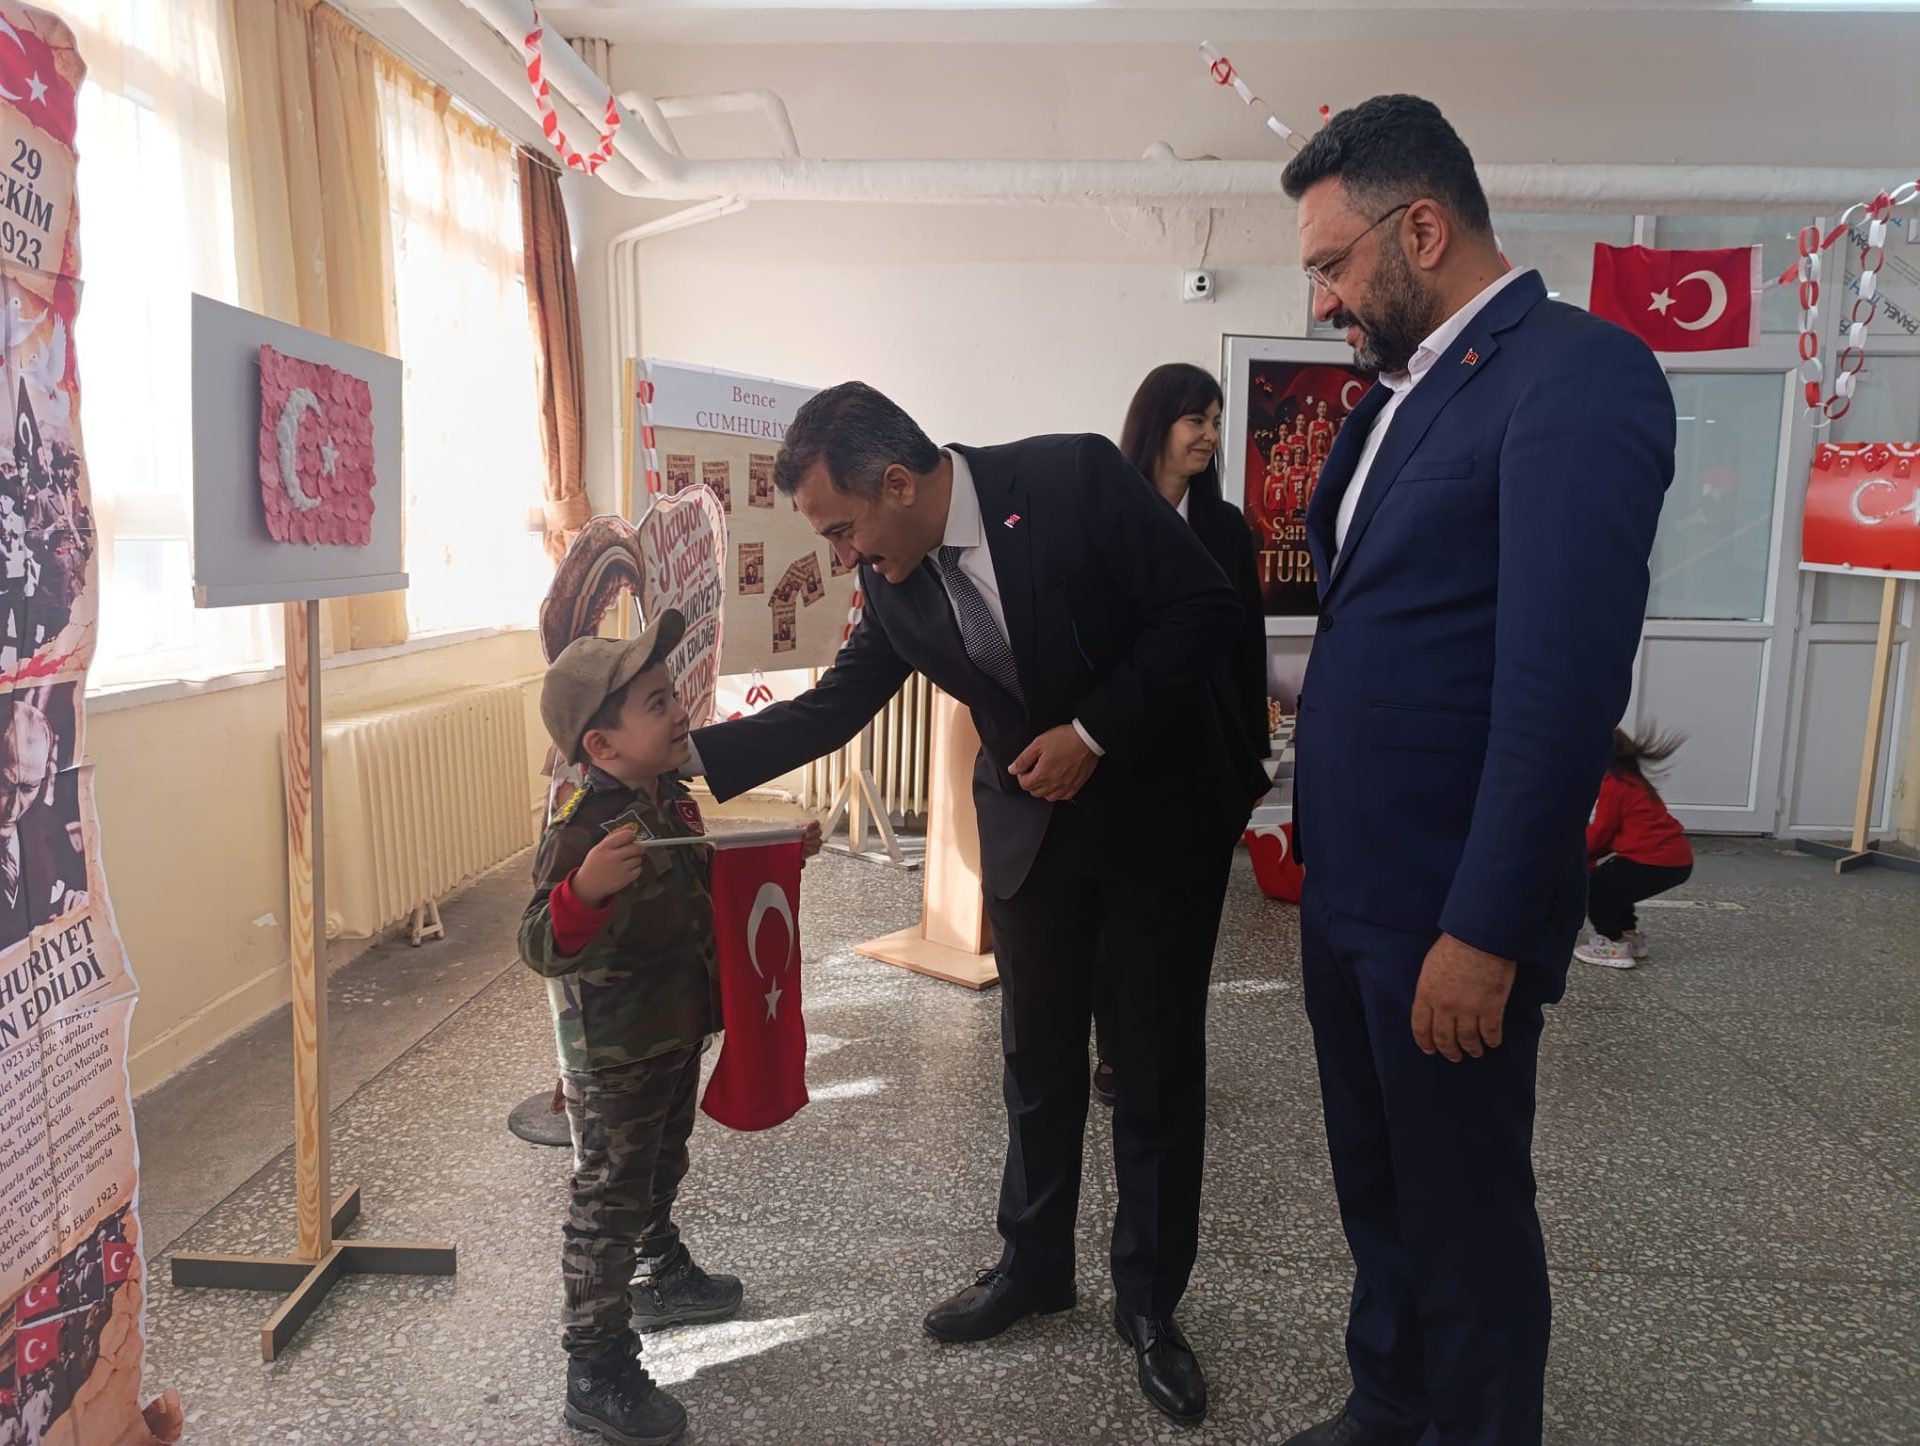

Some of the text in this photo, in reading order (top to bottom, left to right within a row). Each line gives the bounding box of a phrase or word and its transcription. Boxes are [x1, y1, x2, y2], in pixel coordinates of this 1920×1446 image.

[11, 139, 43, 180] 29
[0, 220, 42, 269] 923
[1883, 301, 1920, 334] PANEL
[732, 386, 776, 409] Bence
[651, 497, 704, 594] Yazıyor
[672, 529, 714, 604] yazıyor
[20, 947, 106, 1031] EDİLDİ
[55, 1027, 110, 1067] Cumhuriyet
[59, 1021, 94, 1050] yapılan
[2, 1050, 24, 1075] 1923
[1, 1106, 25, 1134] kabul
[52, 1067, 73, 1088] Gazi
[74, 1042, 109, 1072] Mustafa
[9, 1184, 28, 1212] yeni
[17, 1195, 40, 1217] Türk
[60, 1225, 71, 1242] 29
[72, 1206, 95, 1230] Ekim
[96, 1182, 119, 1209] 1923
